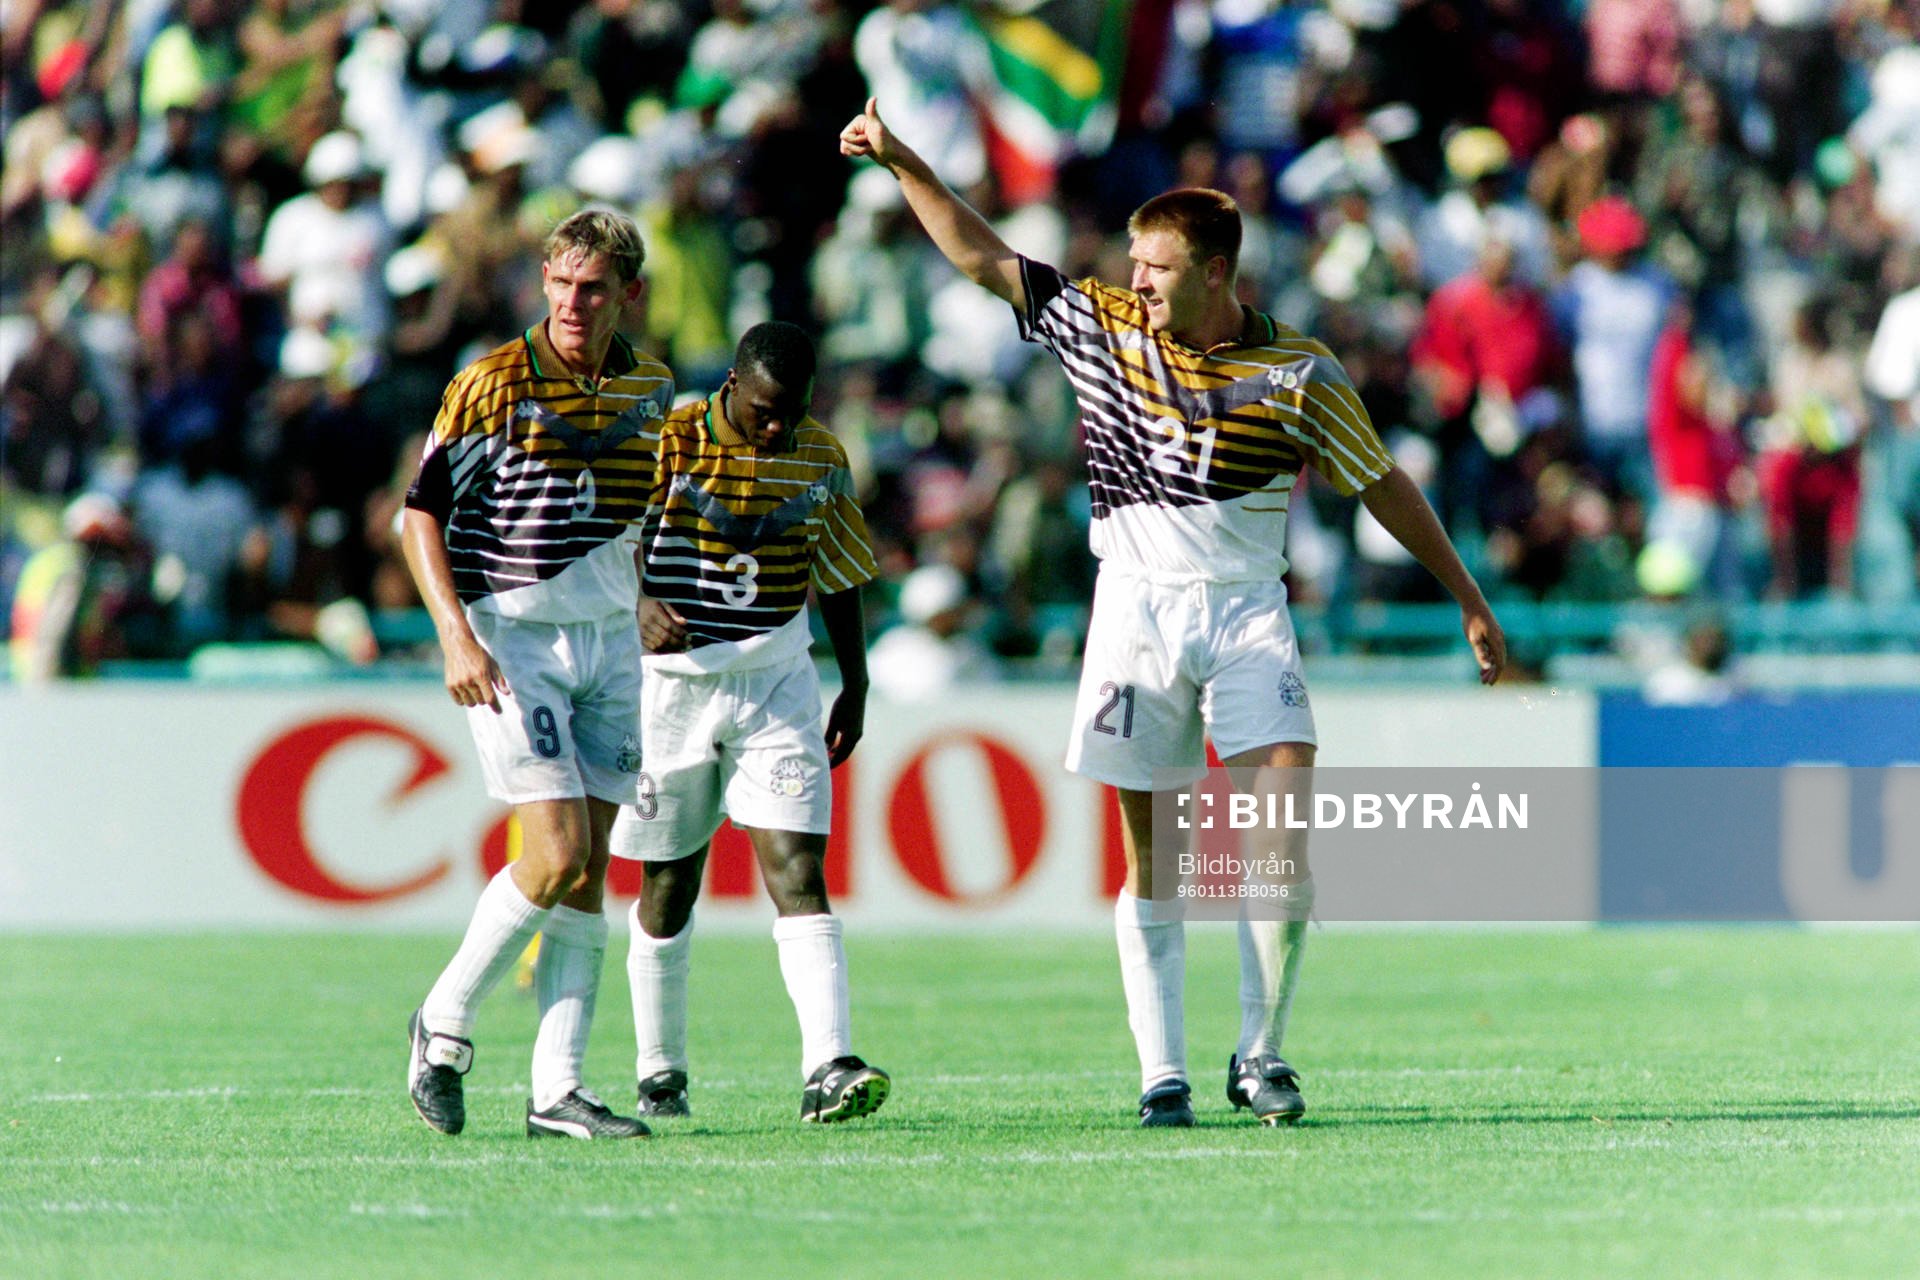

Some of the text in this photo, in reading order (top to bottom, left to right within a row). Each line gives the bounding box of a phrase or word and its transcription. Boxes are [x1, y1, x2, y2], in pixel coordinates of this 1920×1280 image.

[1148, 416, 1217, 482] 21
[721, 553, 760, 609] 3
[532, 705, 561, 758] 9
[1093, 680, 1135, 738] 21
[635, 771, 659, 820] 3
